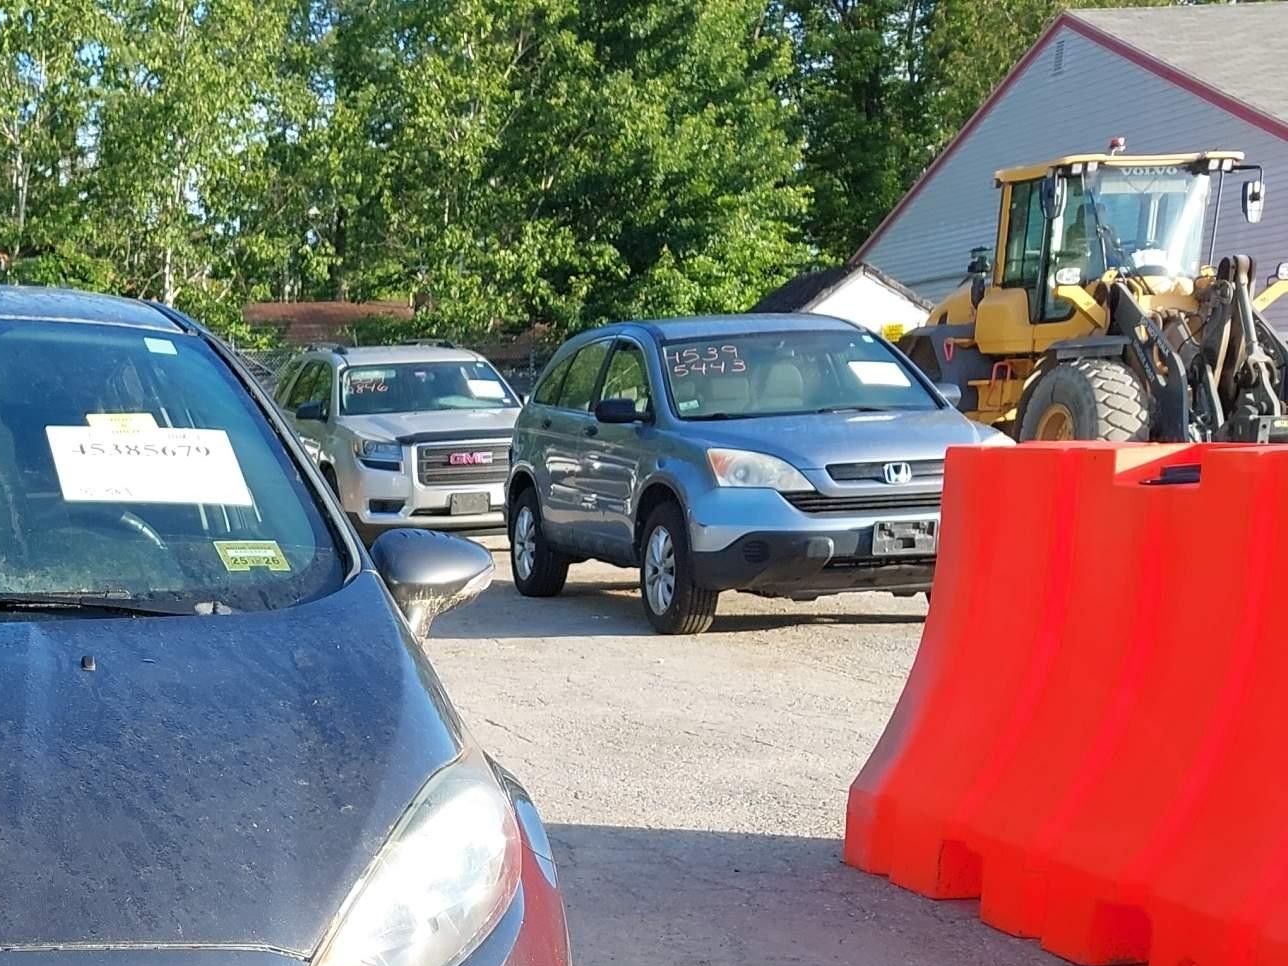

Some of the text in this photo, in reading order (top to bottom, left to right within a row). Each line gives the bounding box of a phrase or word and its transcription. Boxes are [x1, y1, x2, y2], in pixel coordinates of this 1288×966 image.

[1120, 166, 1178, 176] VOLVO
[674, 360, 746, 377] 5443
[450, 451, 493, 465] GMC
[230, 556, 249, 565] 25
[263, 556, 280, 565] 26
